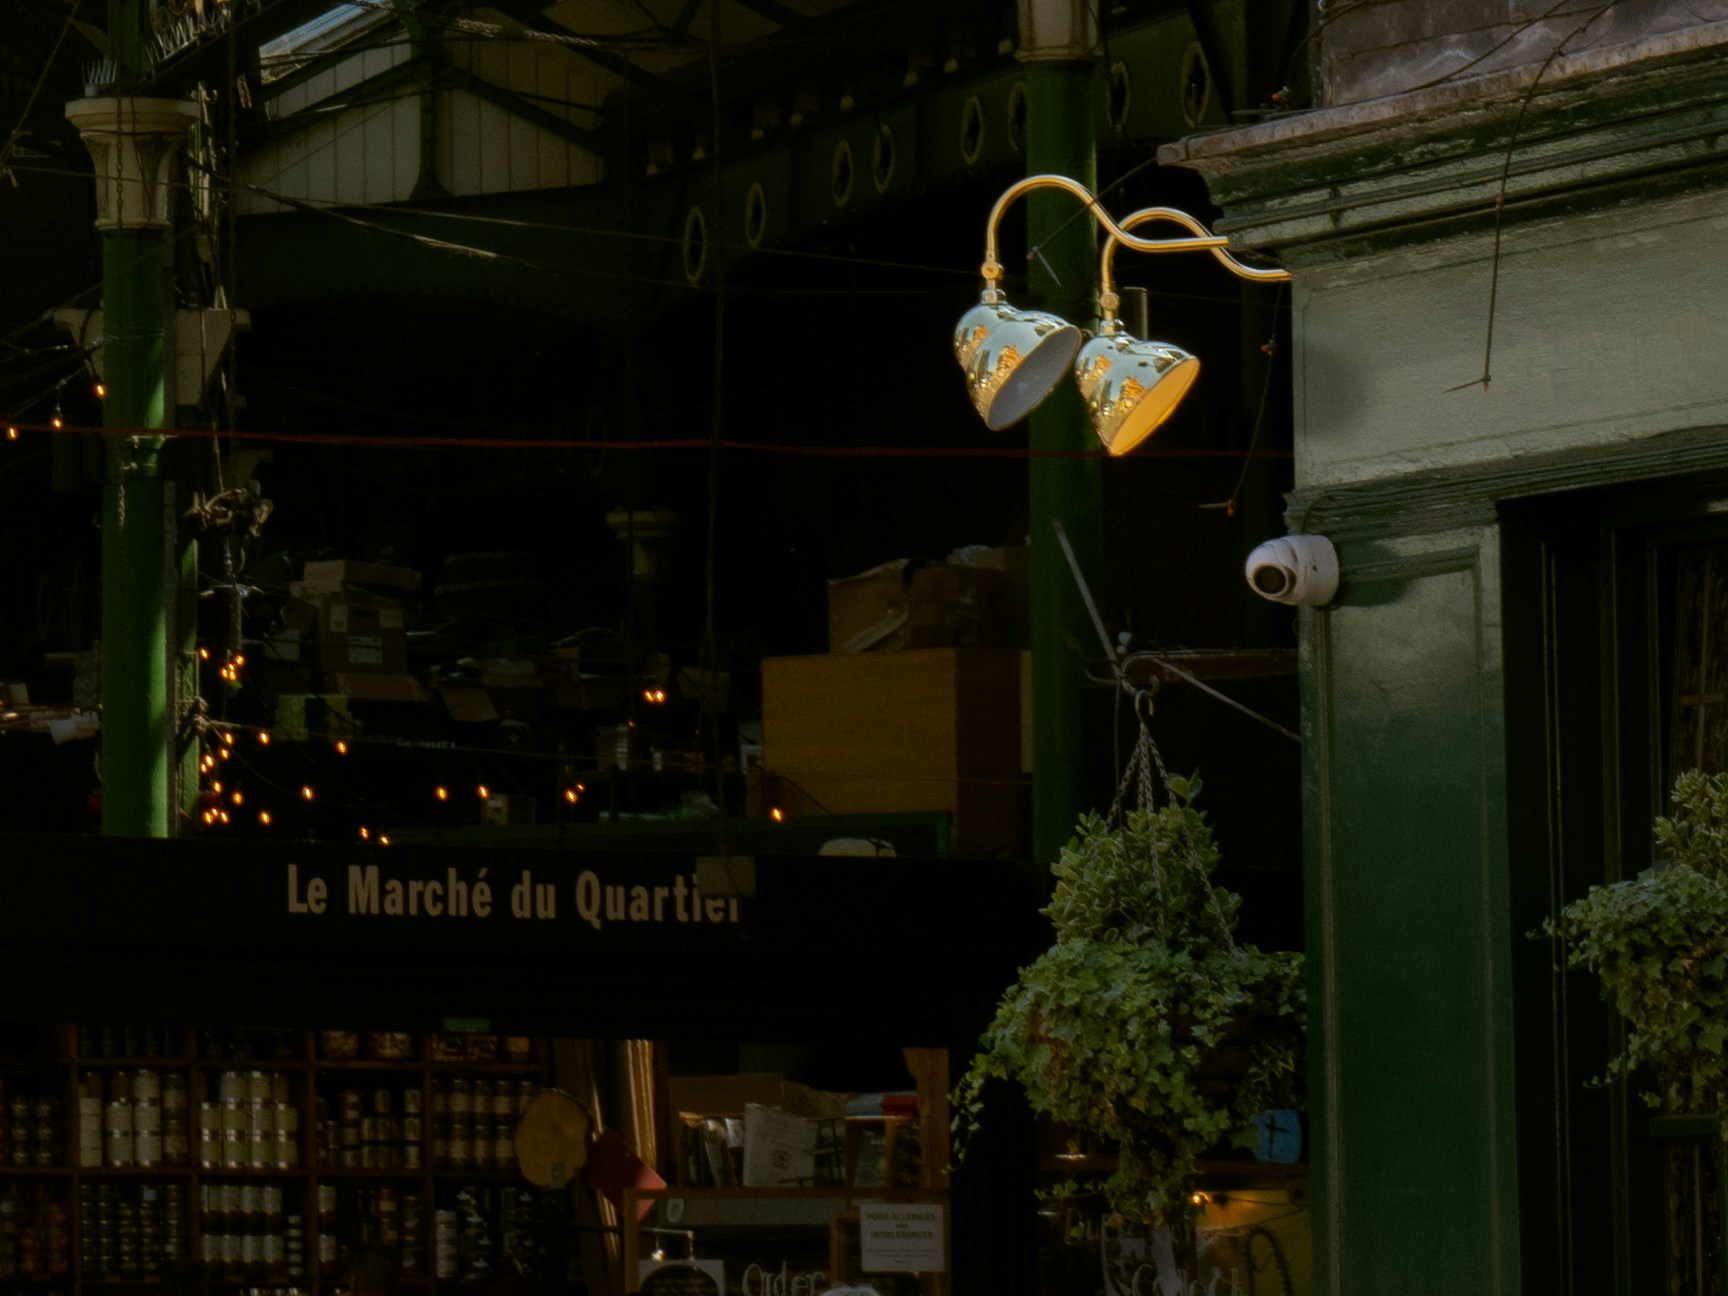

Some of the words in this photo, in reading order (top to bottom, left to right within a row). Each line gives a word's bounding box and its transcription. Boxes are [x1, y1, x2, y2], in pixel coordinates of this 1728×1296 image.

[287, 864, 328, 914] Le
[347, 866, 492, 920] Marché
[510, 870, 556, 921] du
